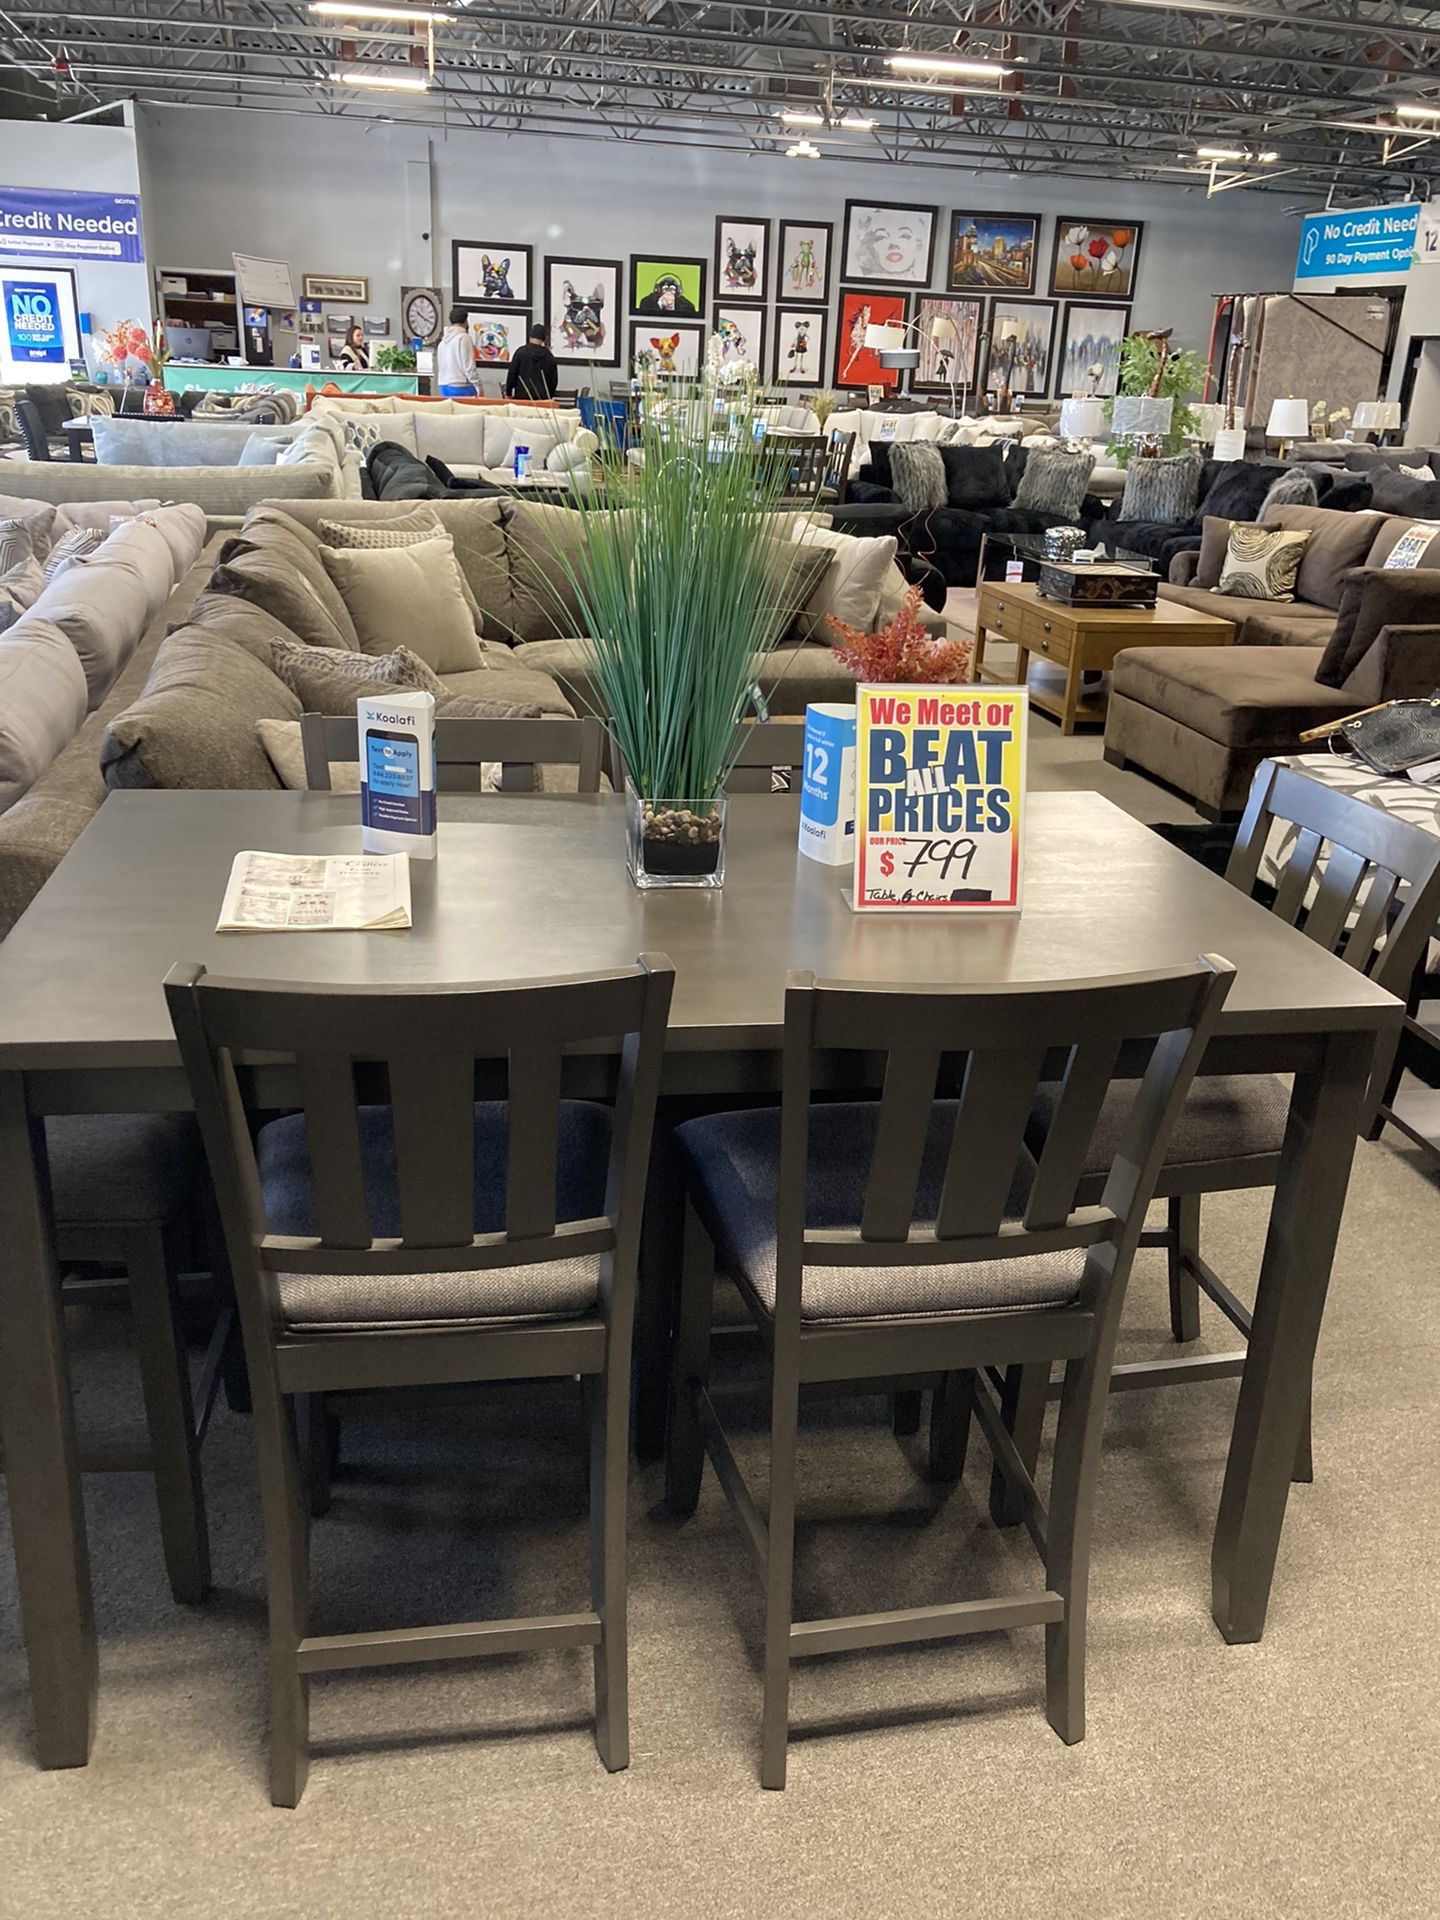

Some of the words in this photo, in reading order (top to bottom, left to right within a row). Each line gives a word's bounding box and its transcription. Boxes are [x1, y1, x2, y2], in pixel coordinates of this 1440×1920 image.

[57, 213, 138, 235] Needed
[1324, 223, 1341, 240] No
[1342, 216, 1381, 238] Credit
[1383, 212, 1419, 234] Need
[1425, 230, 1439, 252] 12
[1325, 253, 1336, 266] 90
[1337, 253, 1353, 266] Day
[1354, 250, 1390, 264] Payment
[11, 294, 52, 316] NO
[13, 314, 54, 323] CREDIT
[14, 321, 55, 331] NEEDED
[376, 712, 416, 727] Koalafi
[869, 697, 911, 726] We
[917, 697, 982, 727] Meet
[986, 701, 1014, 727] or
[806, 742, 830, 786] 12
[869, 728, 1013, 785] BEAT
[803, 782, 830, 801] Months
[904, 765, 951, 797] ALL
[868, 787, 1012, 834] PRICES
[869, 837, 885, 846] OUR
[902, 837, 979, 881] 799
